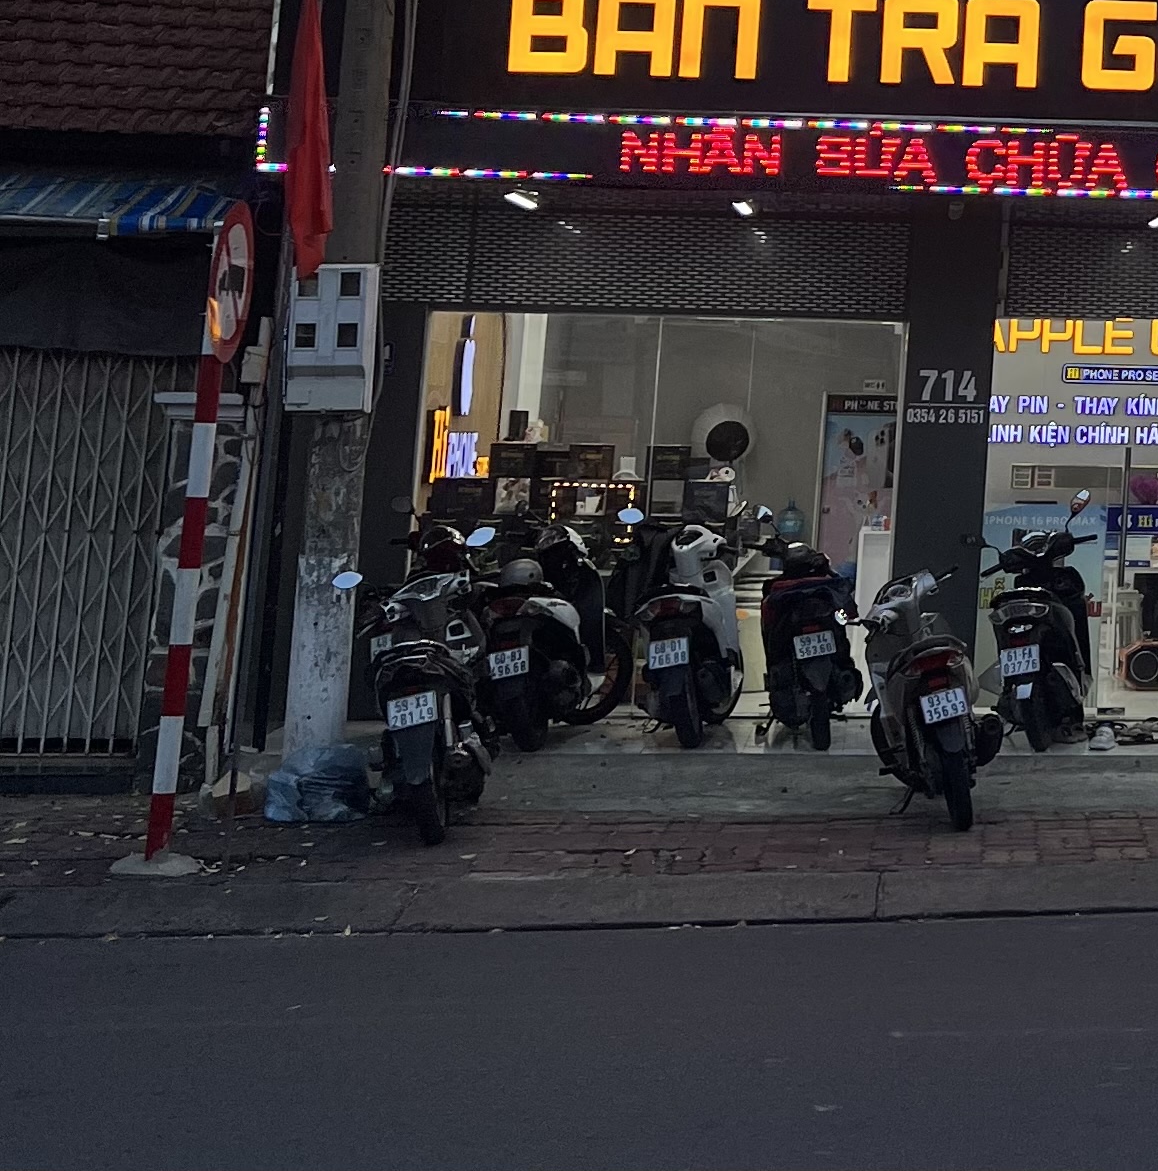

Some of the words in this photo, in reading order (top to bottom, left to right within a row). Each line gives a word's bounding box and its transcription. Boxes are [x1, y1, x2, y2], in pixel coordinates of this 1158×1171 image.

[1121, 370, 1144, 380] PRO
[919, 369, 977, 402] 714
[1018, 395, 1048, 414] PIN
[1074, 396, 1118, 415] THAY
[906, 408, 935, 423] 0354
[938, 408, 955, 423] 26
[957, 408, 984, 424] 5151
[1029, 421, 1069, 447] KIỆN
[1075, 421, 1130, 445] CHÍNH
[1031, 516, 1043, 526] 16
[1069, 517, 1098, 526] MAX
[927, 701, 967, 721] 356.93
